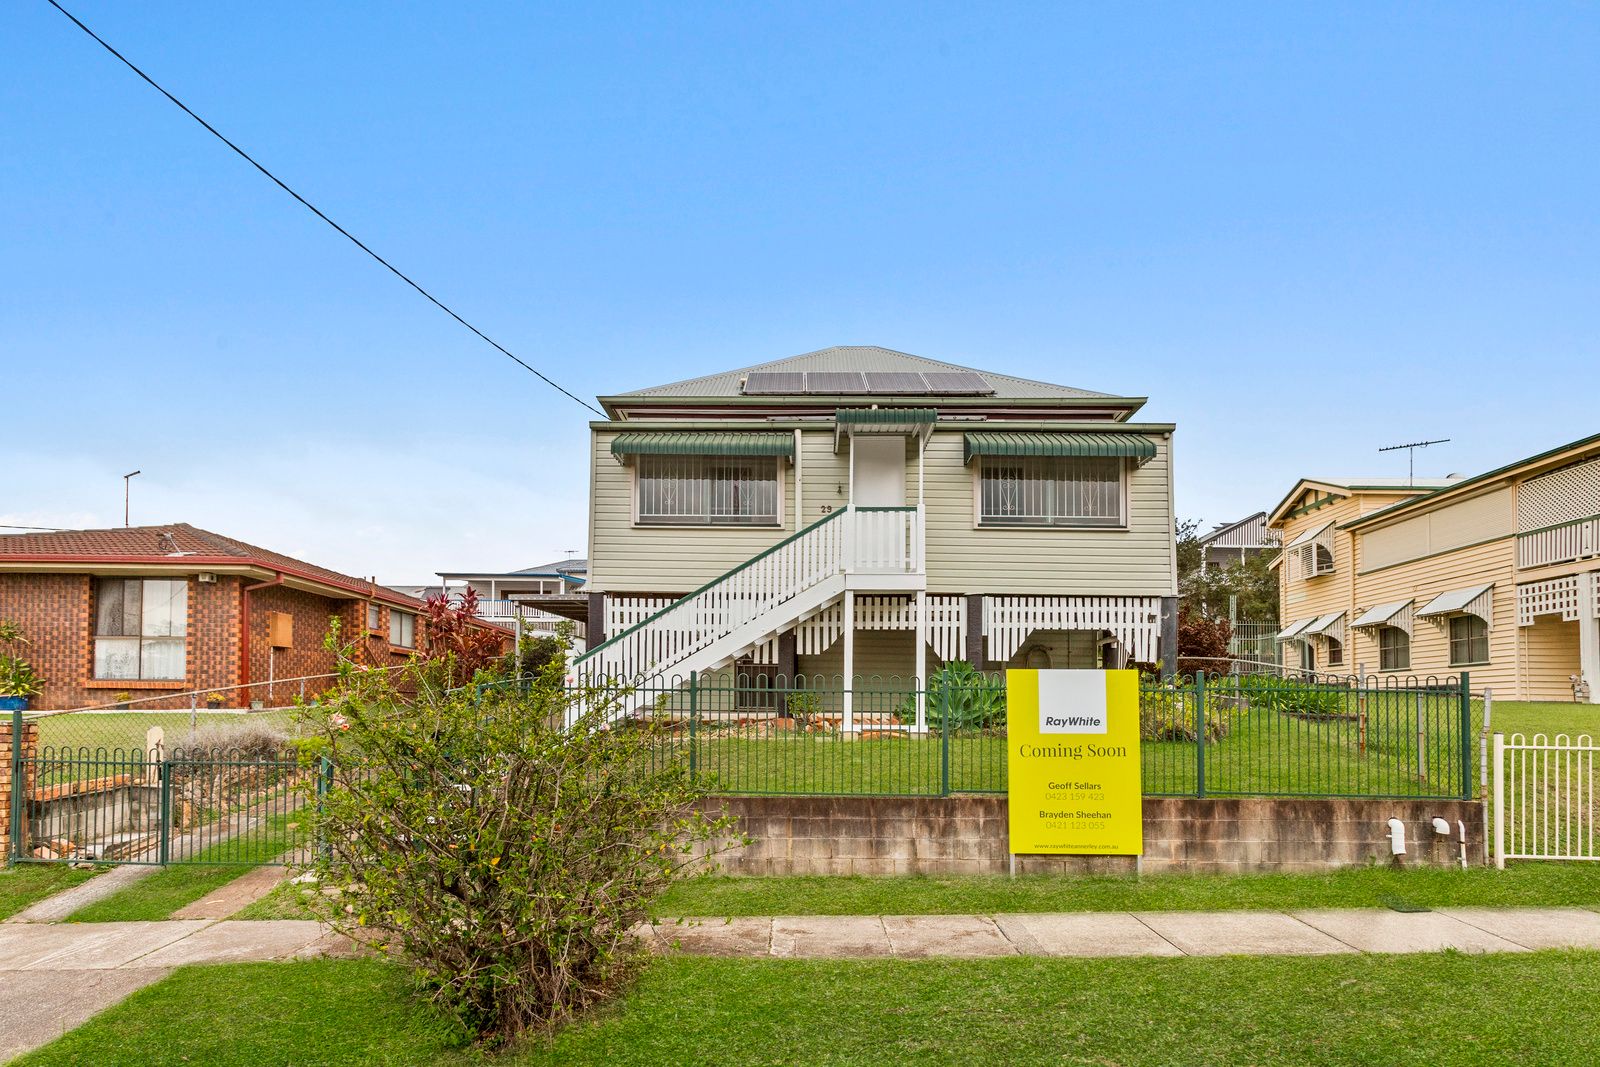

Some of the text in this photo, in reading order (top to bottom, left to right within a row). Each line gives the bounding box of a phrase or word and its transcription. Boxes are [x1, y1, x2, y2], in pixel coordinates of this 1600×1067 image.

[821, 505, 832, 513] 29
[1019, 743, 1127, 760] Coming Soon
[1048, 781, 1102, 790] Geoff Sellars
[1045, 792, 1105, 801] 0423 159 423
[1039, 810, 1112, 820] Brayden Sheehan
[1045, 821, 1067, 830] 0421
[1070, 821, 1086, 830] 123
